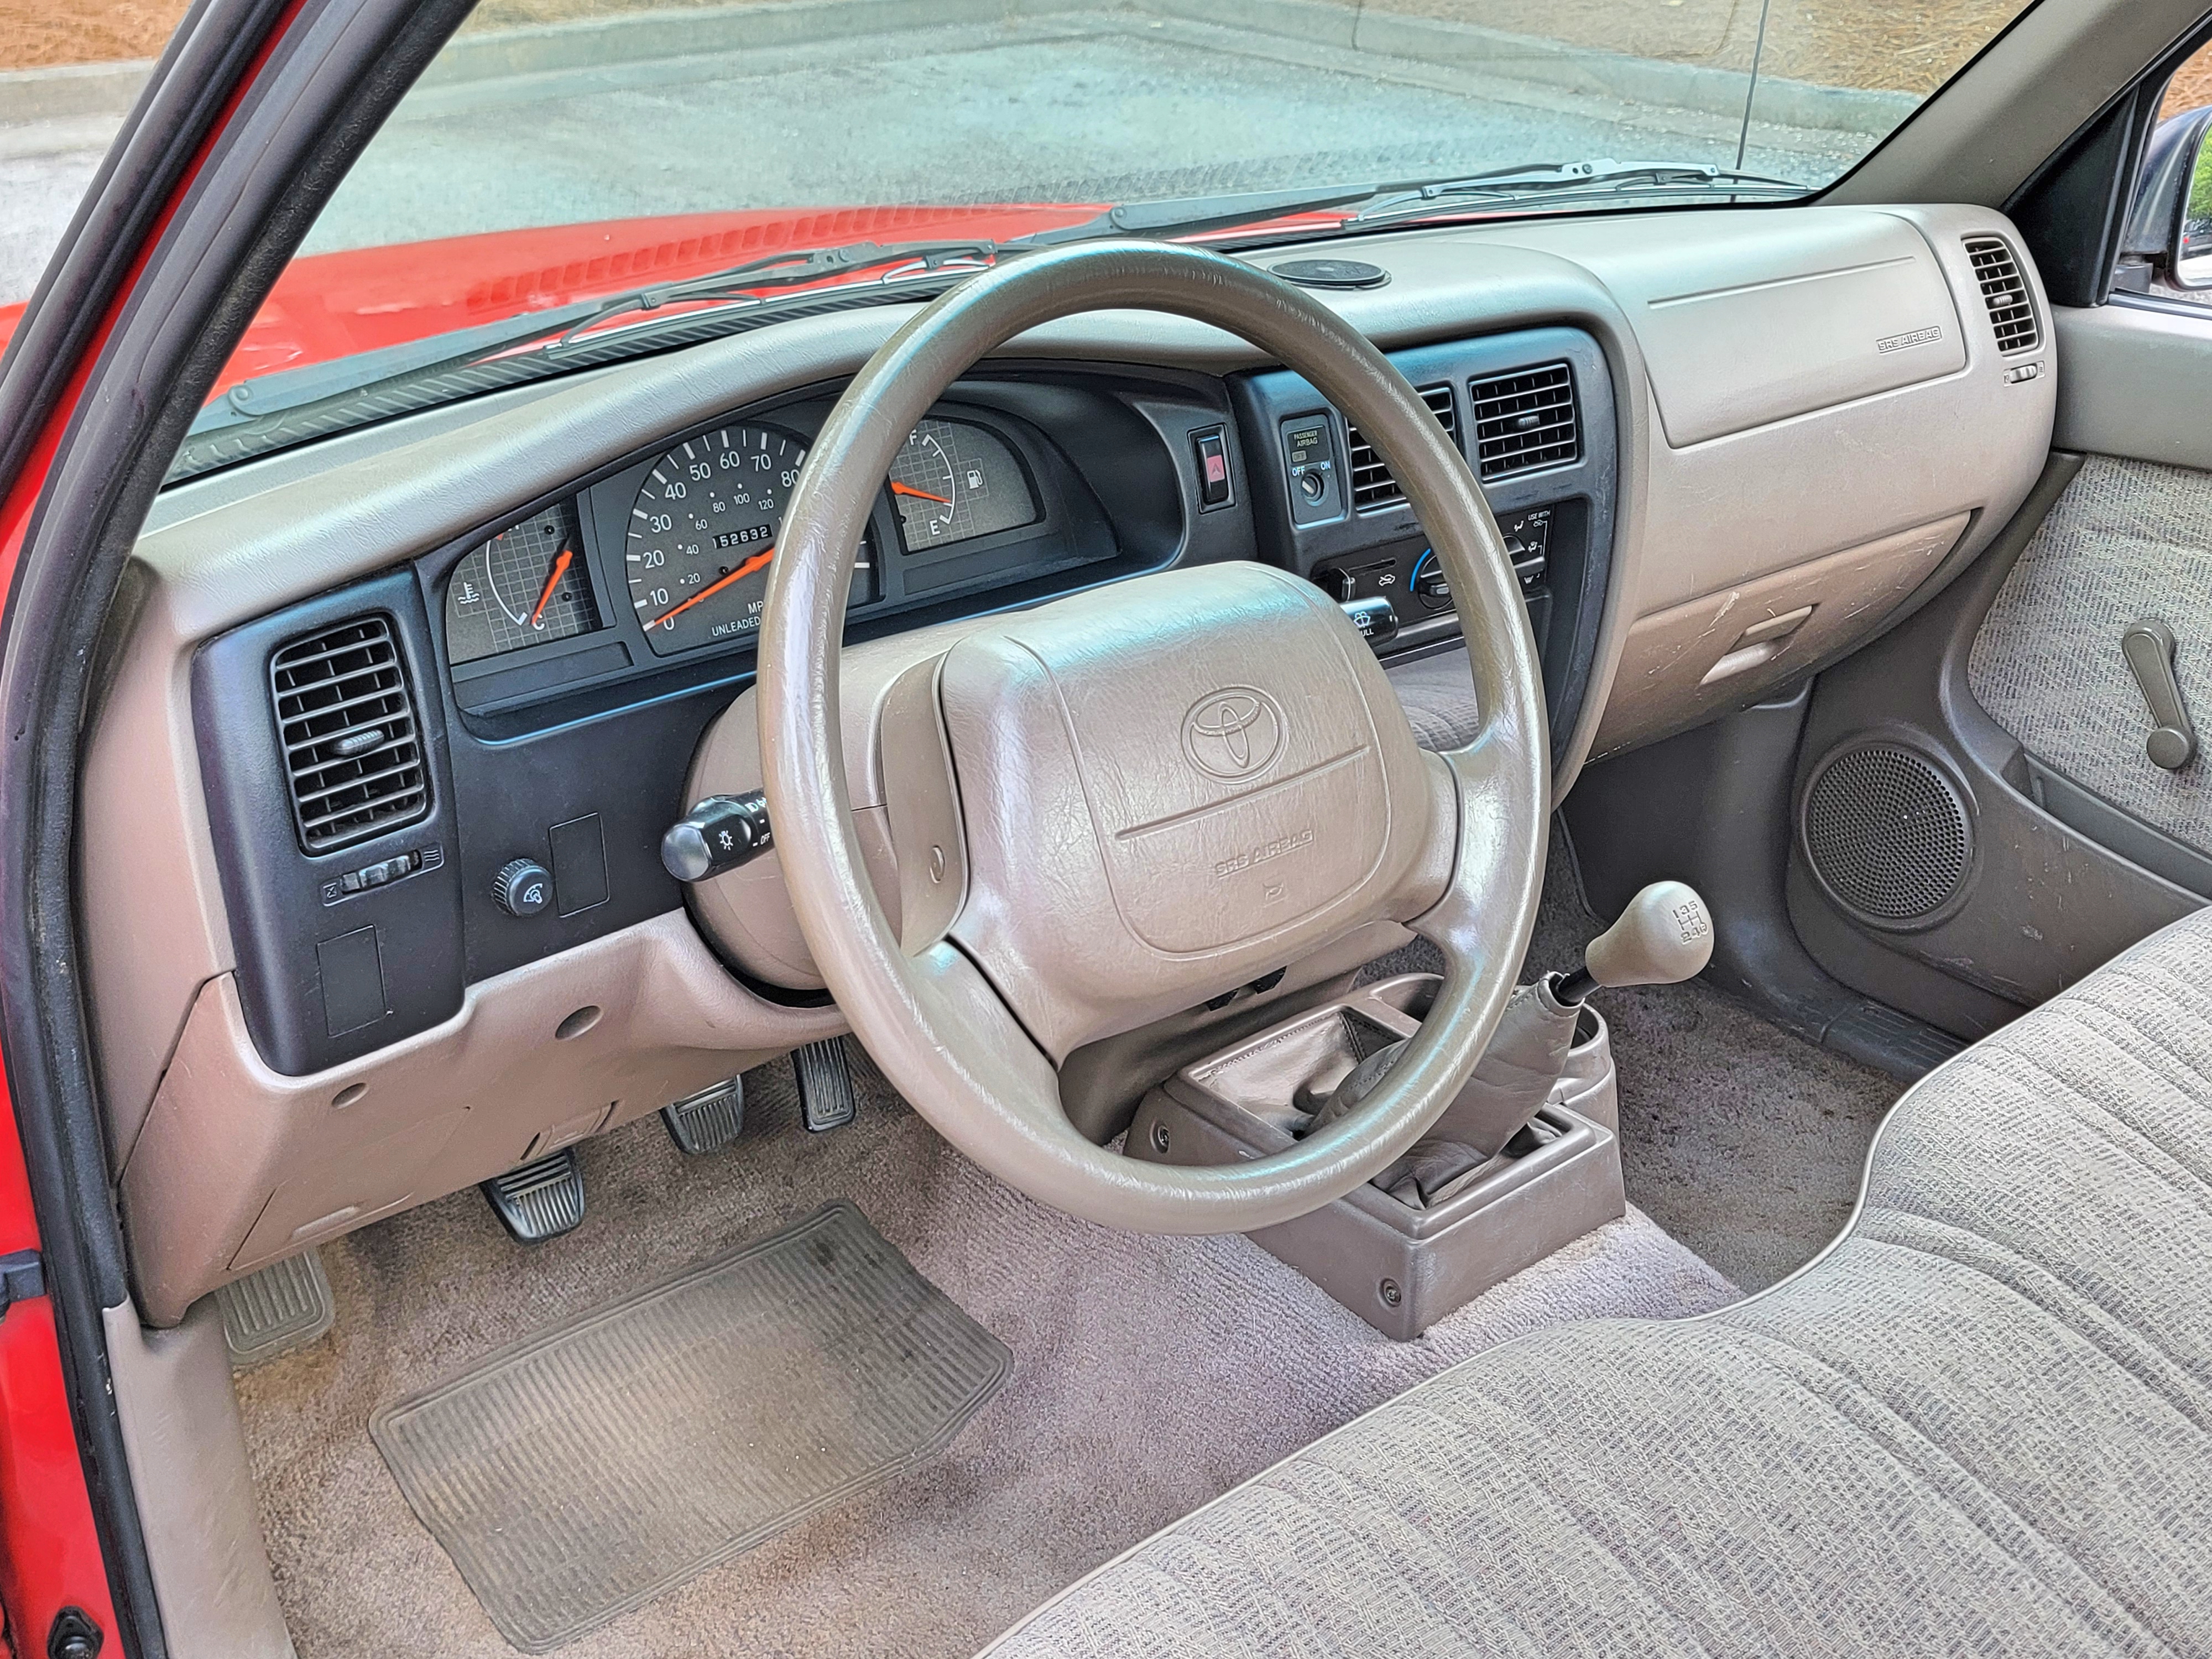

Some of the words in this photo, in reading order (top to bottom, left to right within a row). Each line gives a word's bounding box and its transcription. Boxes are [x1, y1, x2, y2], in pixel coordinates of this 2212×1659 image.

[1878, 339, 1899, 351] SRS
[1901, 329, 1939, 346] AIRBAG
[909, 429, 917, 445] F
[1297, 437, 1318, 447] AIRBAG
[720, 451, 740, 469] 60
[750, 453, 771, 472] 70
[1320, 461, 1331, 471] ON
[689, 462, 711, 481] 50
[781, 469, 800, 487] 80
[1292, 466, 1305, 477] OFF
[665, 482, 687, 500] 40
[733, 493, 750, 505] 100
[758, 498, 774, 510] 120
[712, 501, 726, 513] 80
[650, 514, 672, 534] 30
[695, 519, 708, 530] 60
[930, 520, 940, 535] E
[712, 526, 768, 549] 152632
[686, 544, 700, 555] 40
[643, 550, 665, 569] 20
[687, 573, 701, 584] 20
[650, 588, 669, 606] 10
[748, 601, 764, 614] MP
[664, 615, 675, 630] 0
[711, 616, 761, 637] UNLEADED
[1360, 628, 1374, 637] ULL
[760, 832, 771, 846] OFF
[1215, 855, 1249, 877] SRS
[1253, 830, 1314, 863] AIRBAG
